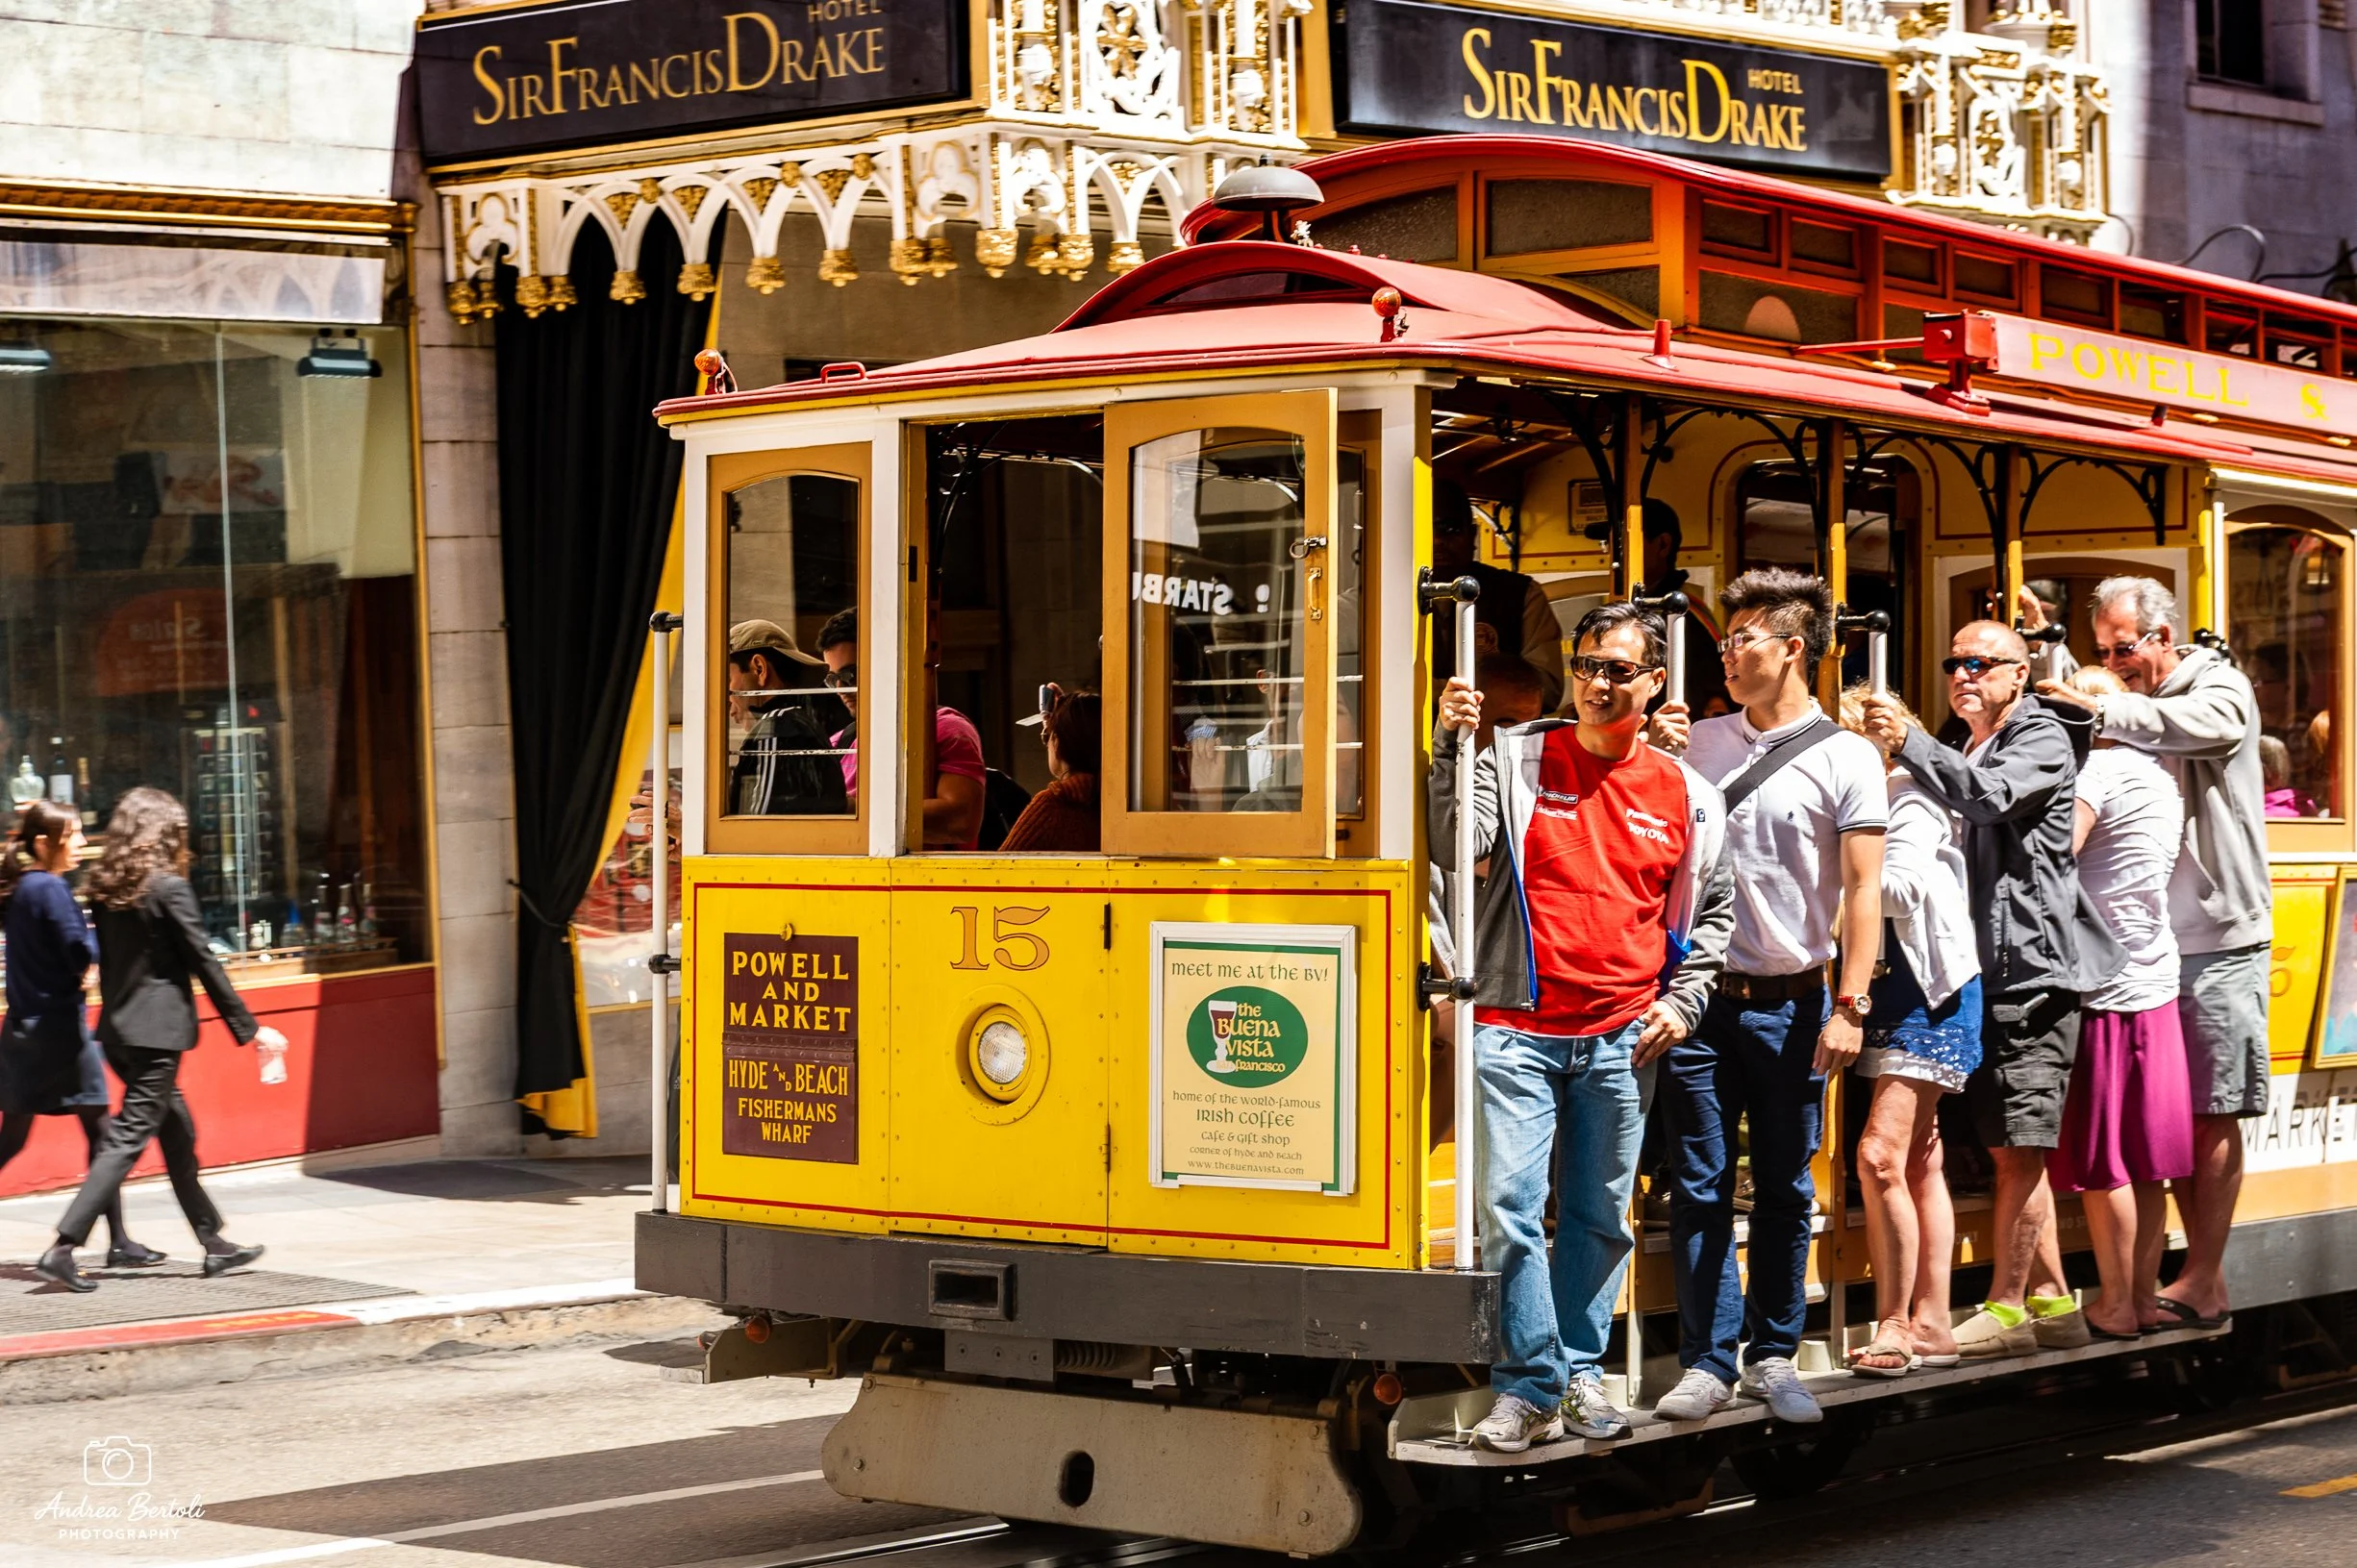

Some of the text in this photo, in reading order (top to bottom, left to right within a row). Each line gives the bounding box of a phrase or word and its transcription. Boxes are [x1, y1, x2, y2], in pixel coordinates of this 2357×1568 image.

[808, 0, 883, 24] HOTEL
[1746, 68, 1803, 94] HOTEL
[2026, 332, 2329, 421] POWELL &
[1626, 821, 1670, 845] TOYOTA
[949, 906, 1051, 972] 15
[732, 950, 849, 981] POWELL
[1247, 964, 1265, 980] at
[1270, 963, 1299, 981] the
[762, 981, 820, 1002] AND
[729, 1002, 852, 1032] MARKET
[1237, 1002, 1262, 1018] the
[728, 1058, 768, 1090] HYDE
[794, 1063, 848, 1096] BEACH
[738, 1097, 838, 1124] FISHERMANS
[1204, 1092, 1216, 1105] of
[1219, 1093, 1239, 1105] the
[761, 1121, 813, 1144] WHARF
[1227, 1132, 1235, 1142] &
[1261, 1132, 1291, 1148] shop
